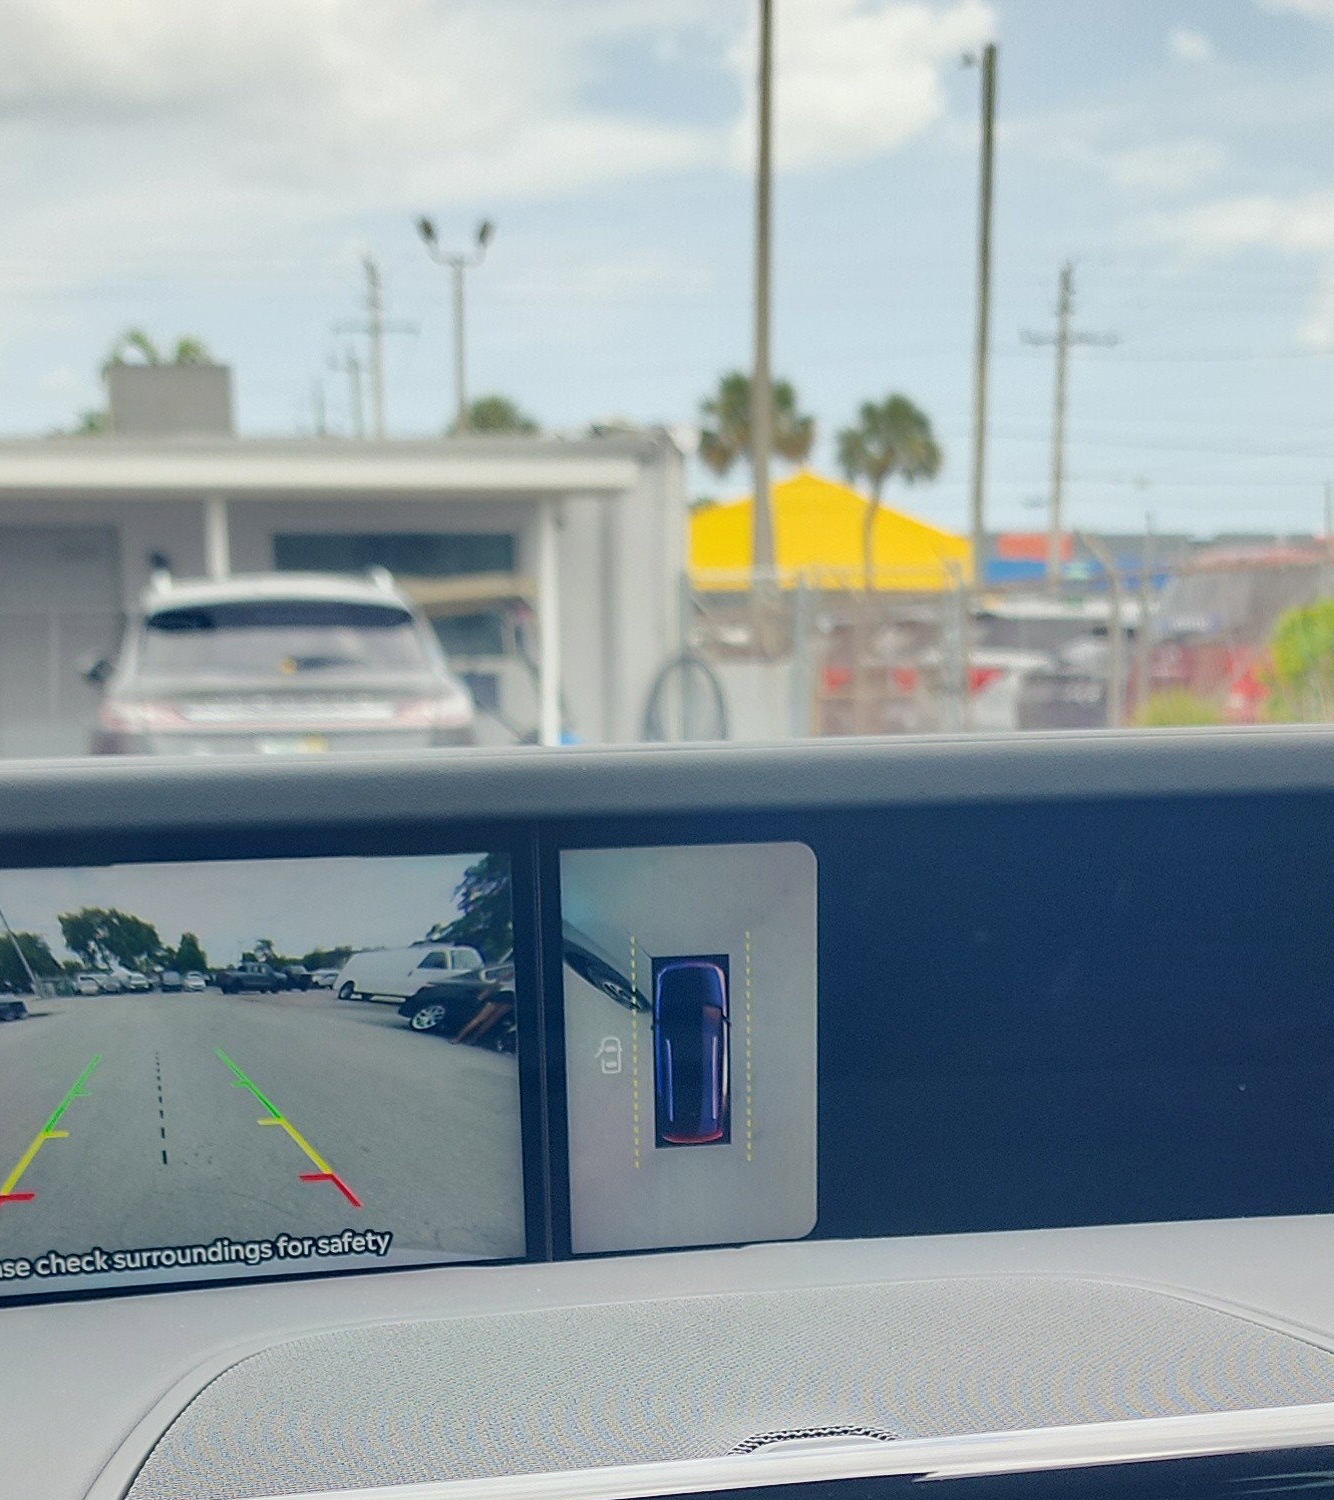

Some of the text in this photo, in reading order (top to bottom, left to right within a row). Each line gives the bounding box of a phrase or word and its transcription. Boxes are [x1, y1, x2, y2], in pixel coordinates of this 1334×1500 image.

[37, 1248, 109, 1275] check
[113, 1235, 271, 1268] surroundings
[276, 1233, 316, 1260] for
[318, 1229, 389, 1256] safety
